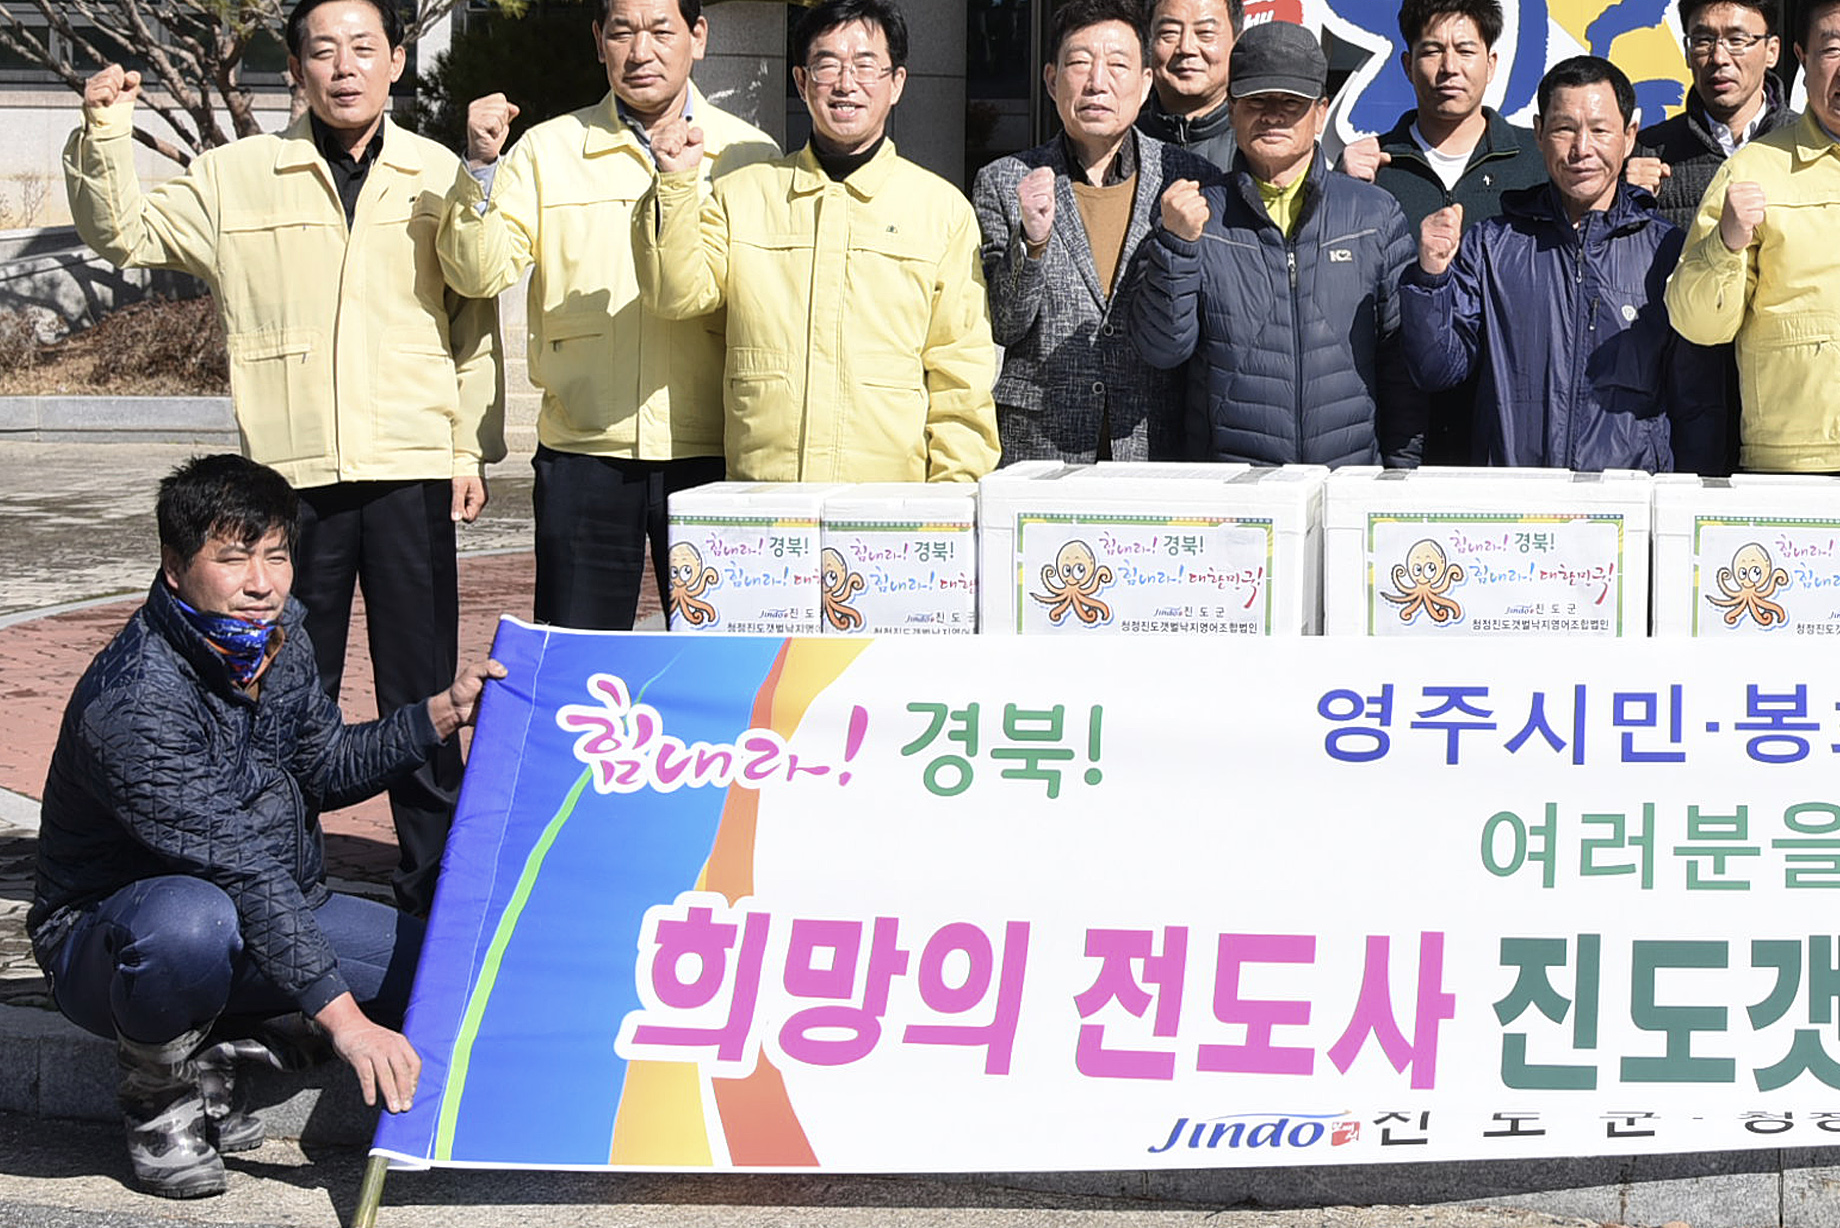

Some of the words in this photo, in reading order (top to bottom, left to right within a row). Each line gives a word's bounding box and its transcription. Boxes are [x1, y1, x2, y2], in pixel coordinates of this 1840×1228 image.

[769, 537, 809, 557] 경북!
[914, 541, 954, 562] 경북!
[1163, 535, 1204, 556] 경북!
[1515, 533, 1555, 554] 경북!
[568, 678, 869, 787] 힘내라!
[901, 702, 1104, 800] 경북!
[631, 906, 1031, 1076] 희망의
[1073, 925, 1456, 1090] 전도사
[1148, 1113, 1326, 1154] Jindo
